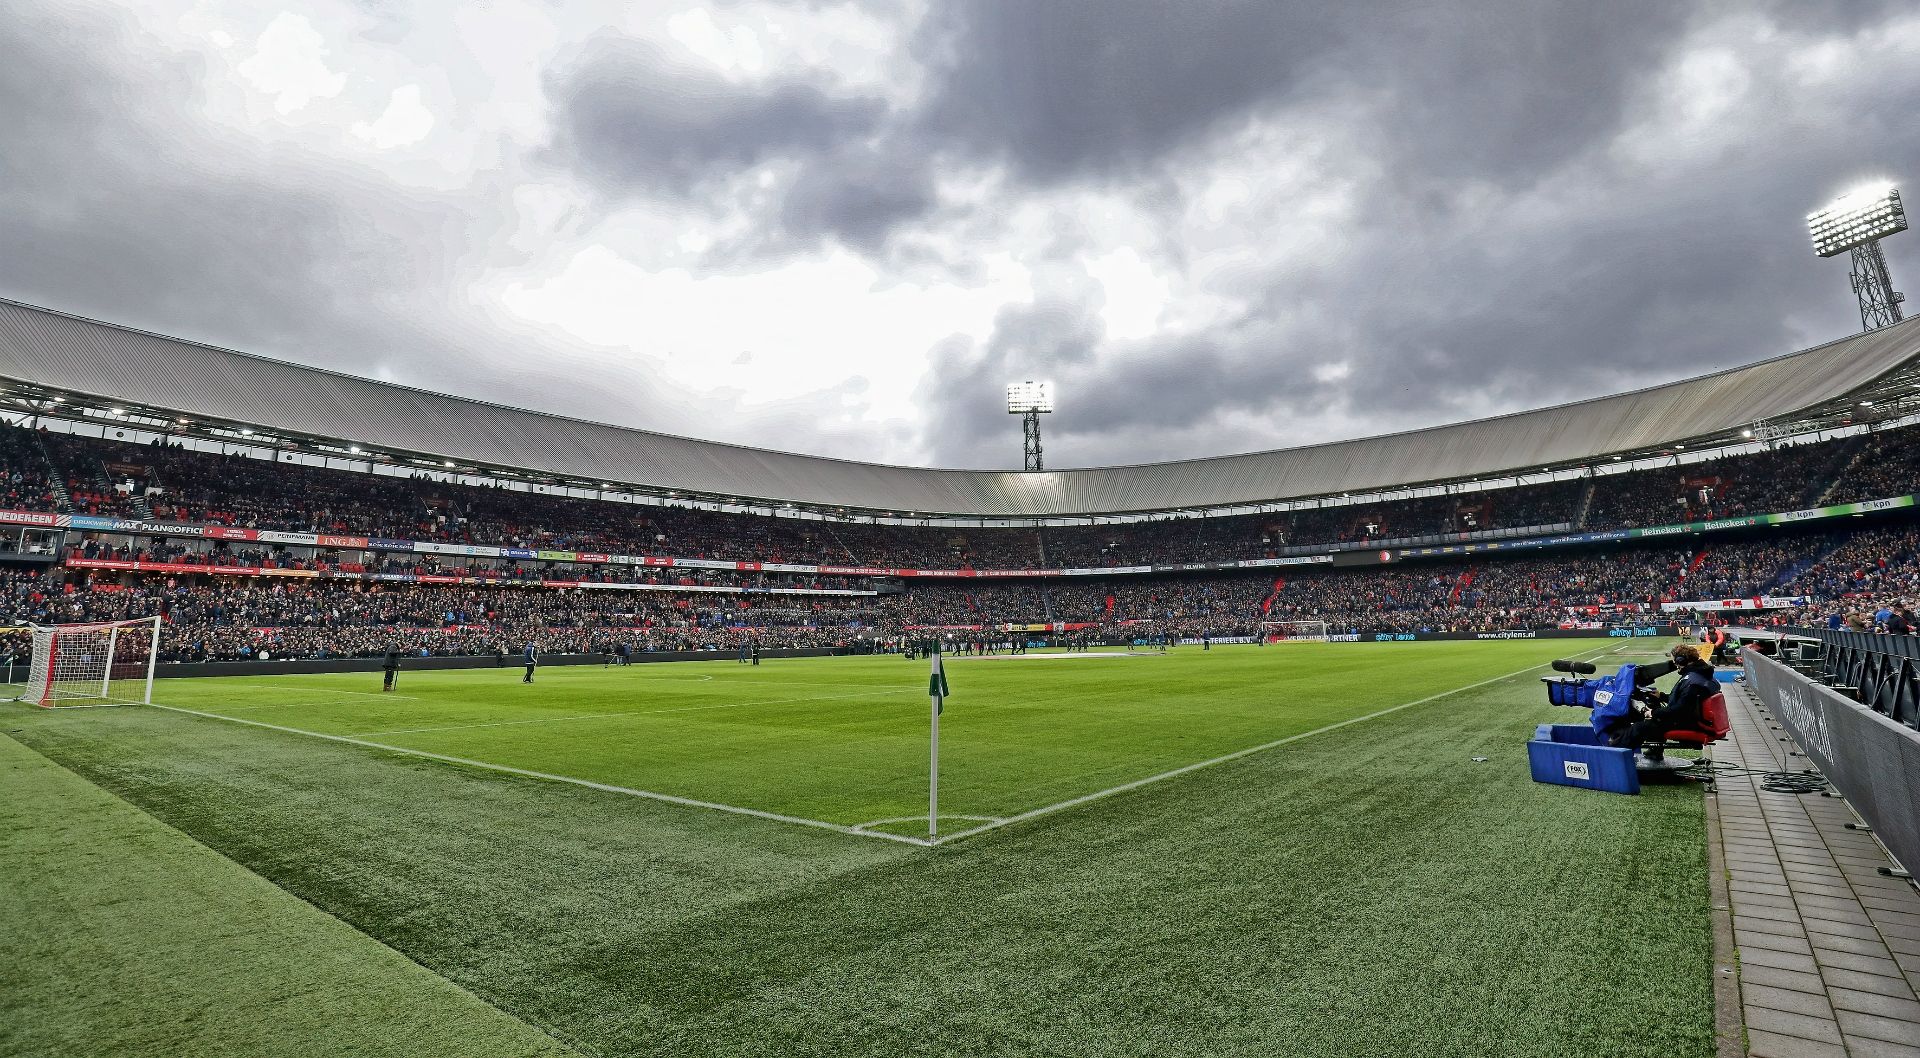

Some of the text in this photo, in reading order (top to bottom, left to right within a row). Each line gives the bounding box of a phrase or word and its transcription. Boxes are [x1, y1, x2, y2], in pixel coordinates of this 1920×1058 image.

[1873, 500, 1891, 508] kpn
[1797, 511, 1814, 519] kpn
[142, 523, 204, 535] PLAN@OFFICE
[1704, 519, 1746, 530] Heineken
[1641, 526, 1682, 536] Heineken
[324, 537, 346, 547] ING
[1477, 631, 1536, 640] www.citylens.nl
